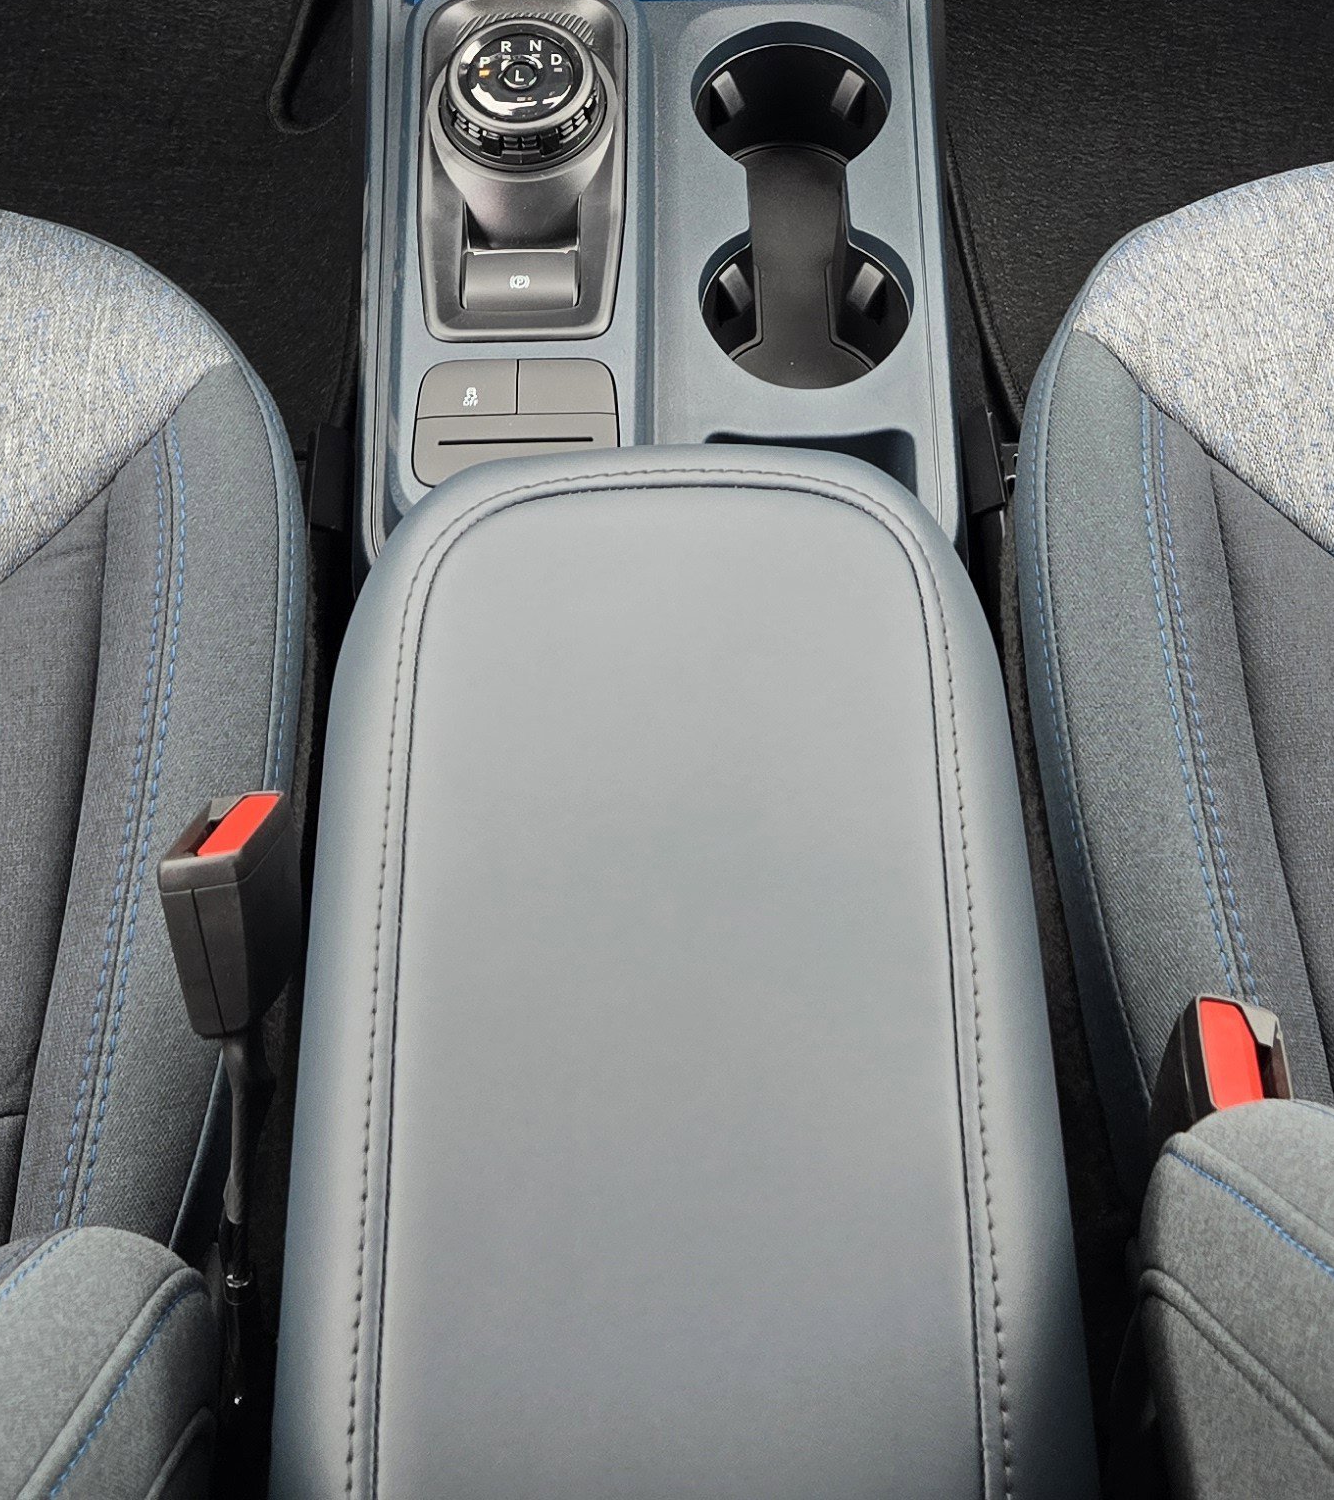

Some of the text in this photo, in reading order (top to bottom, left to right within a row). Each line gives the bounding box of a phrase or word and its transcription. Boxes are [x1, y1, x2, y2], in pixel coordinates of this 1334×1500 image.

[500, 40, 512, 53] R
[529, 39, 542, 52] N
[479, 56, 491, 69] P
[550, 53, 563, 66] D
[514, 69, 525, 82] L
[463, 399, 479, 407] OFF
